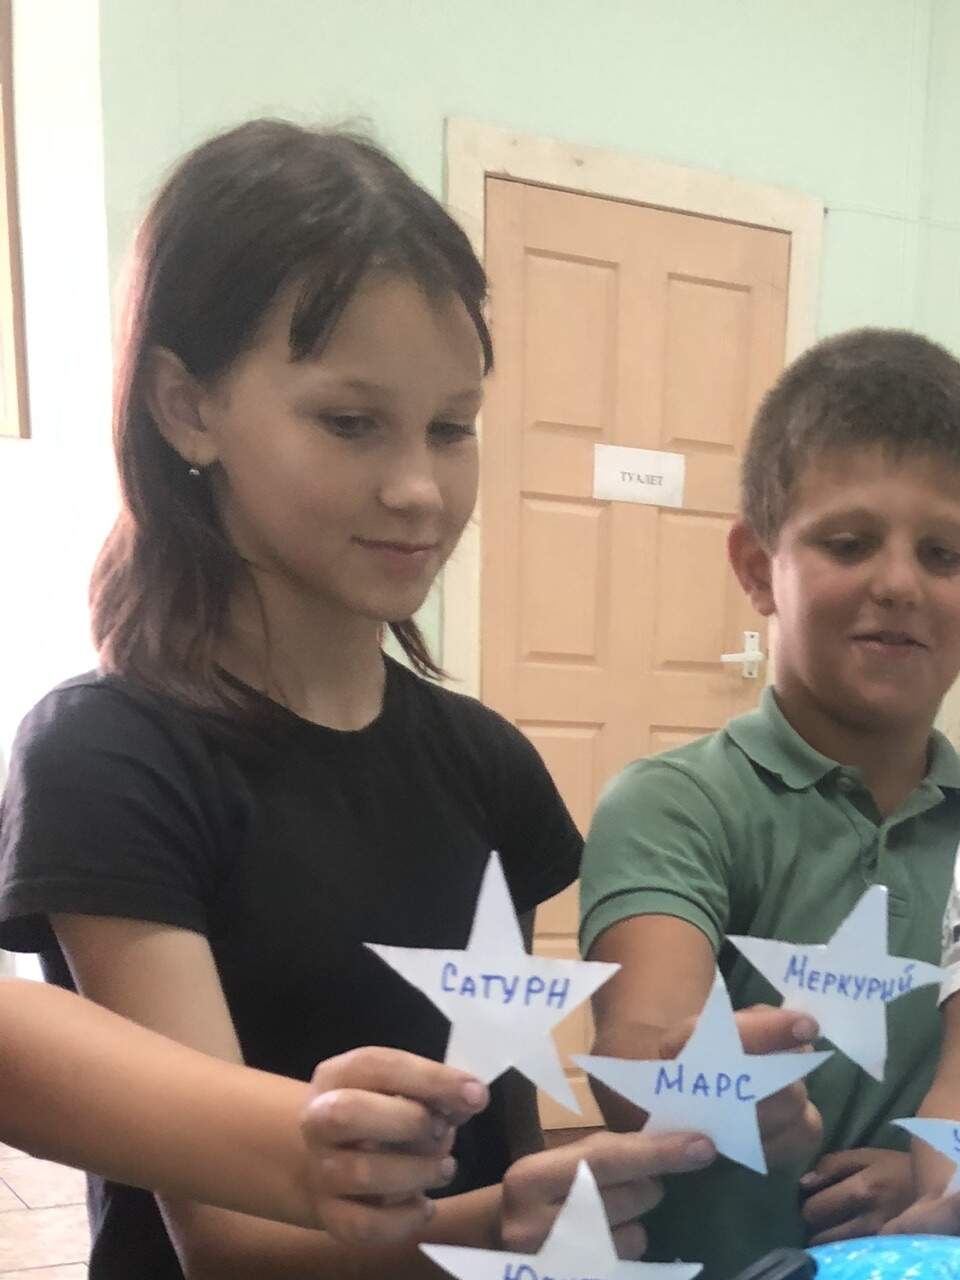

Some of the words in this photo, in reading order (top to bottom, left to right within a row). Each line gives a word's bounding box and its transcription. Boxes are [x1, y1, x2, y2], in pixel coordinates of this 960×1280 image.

[440, 962, 570, 1009] САТУРН
[783, 954, 916, 1001] МЕРКУРИЙ
[655, 1064, 756, 1101] МАРС
